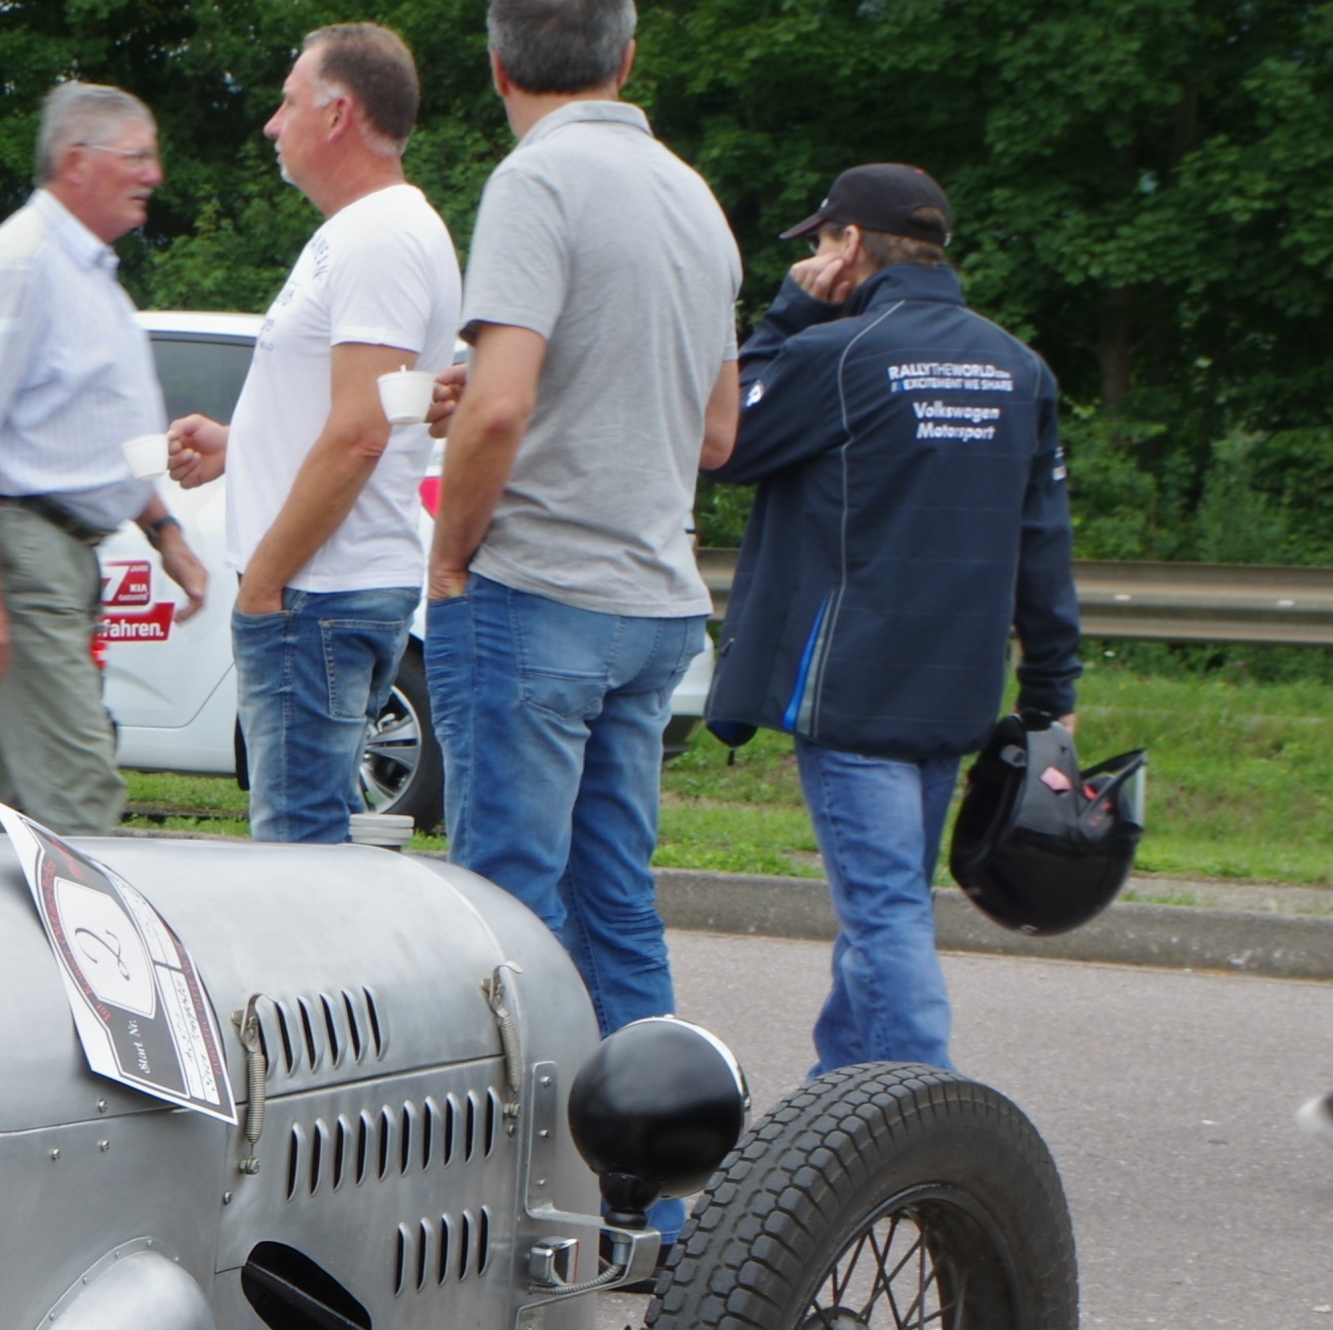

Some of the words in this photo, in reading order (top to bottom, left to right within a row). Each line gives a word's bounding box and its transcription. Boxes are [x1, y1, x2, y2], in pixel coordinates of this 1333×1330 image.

[913, 400, 1000, 422] Volkswagen
[916, 421, 995, 442] Motorsport
[129, 584, 148, 593] KIA
[74, 926, 130, 982] 2
[128, 1019, 138, 1038] Nr.
[137, 1040, 151, 1074] Start
